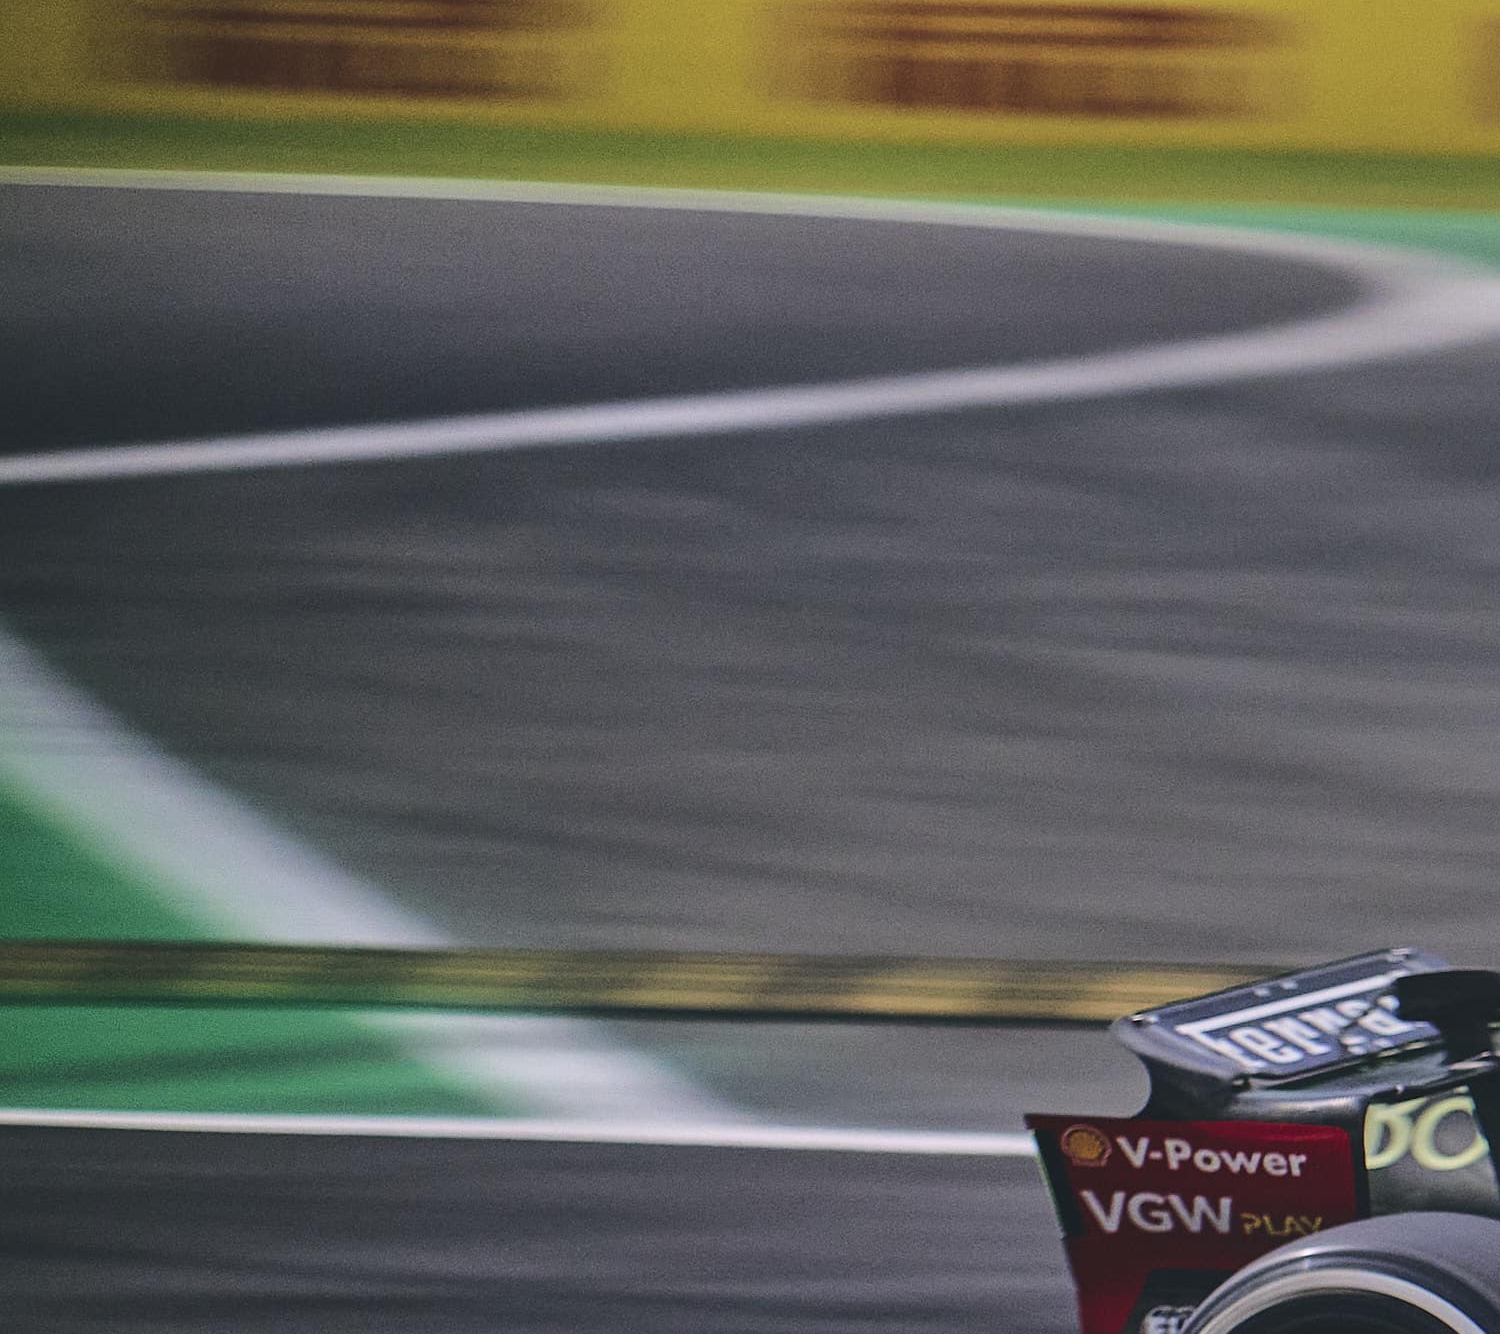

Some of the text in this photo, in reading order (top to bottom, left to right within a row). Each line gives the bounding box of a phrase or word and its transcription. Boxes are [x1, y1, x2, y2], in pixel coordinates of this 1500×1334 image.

[1115, 1135, 1307, 1177] V-Power
[1080, 1188, 1323, 1237] VGW PLAY
